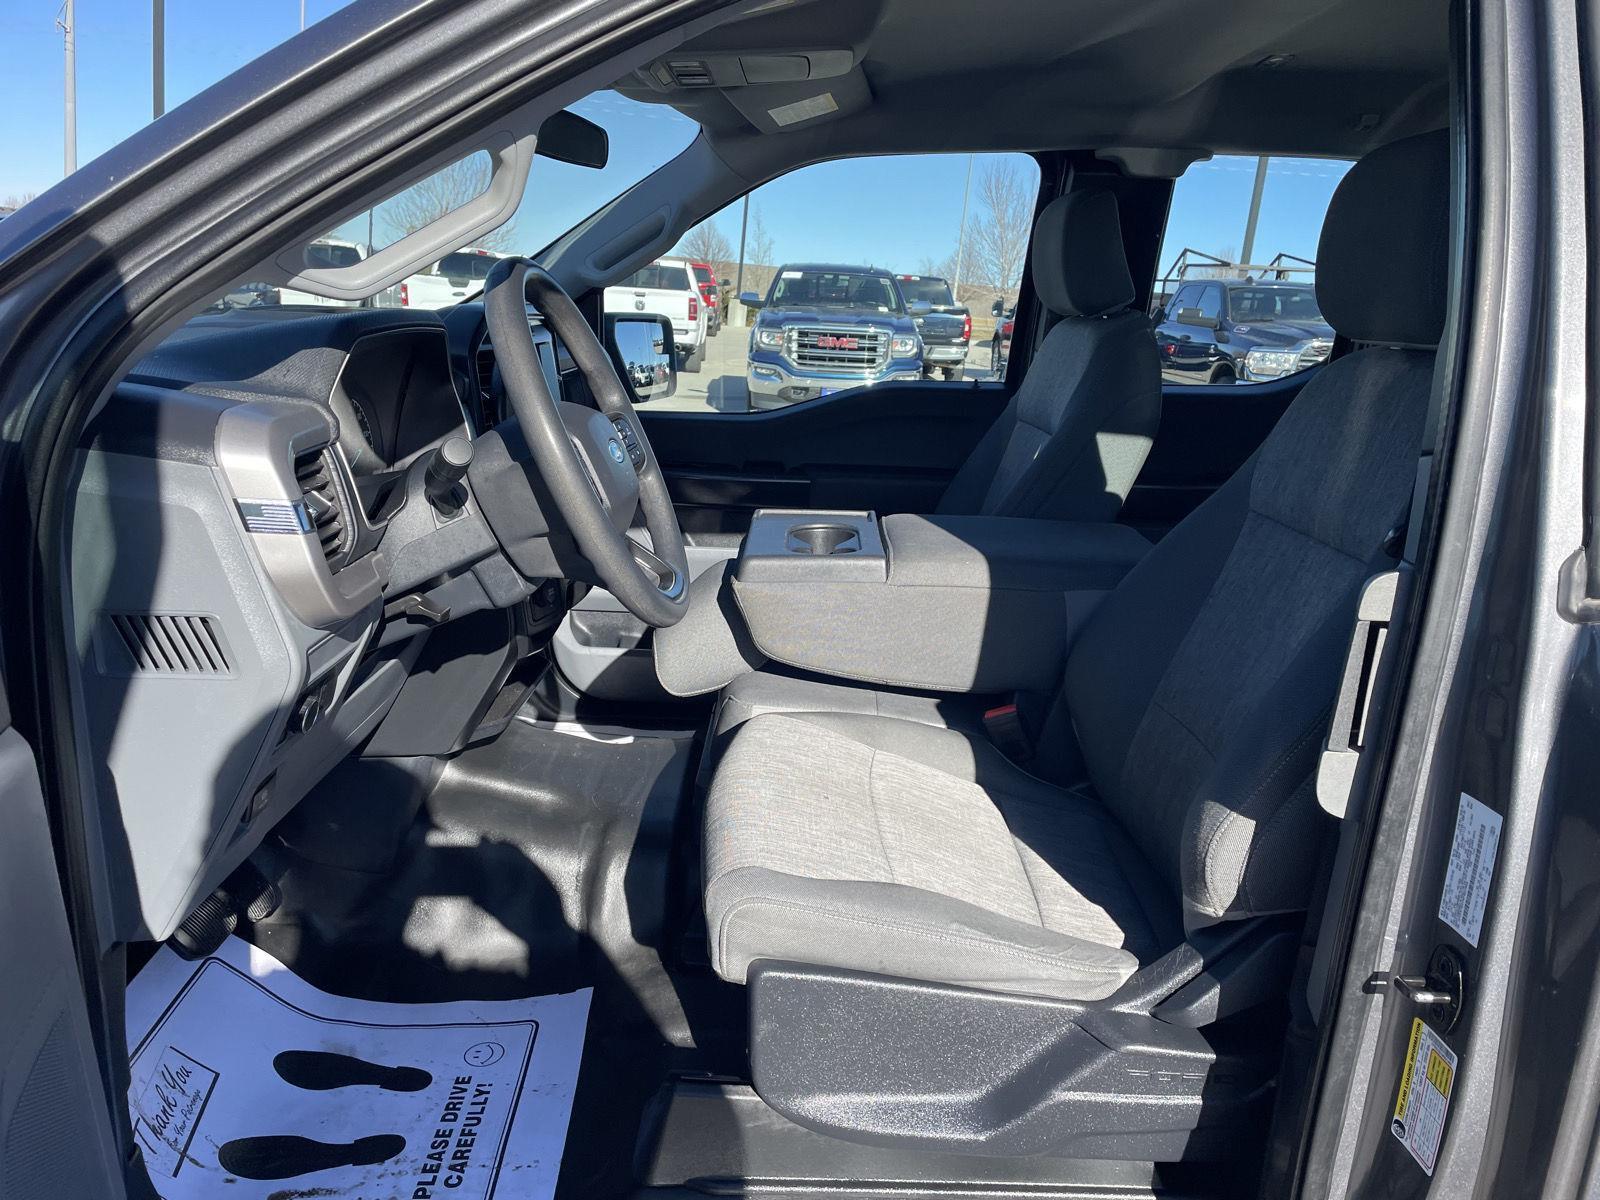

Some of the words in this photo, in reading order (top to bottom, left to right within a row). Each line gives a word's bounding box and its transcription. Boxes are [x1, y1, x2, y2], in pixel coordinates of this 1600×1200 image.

[817, 335, 859, 350] GMC
[1404, 1063, 1413, 1089] LOADING
[1410, 1022, 1421, 1063] INFORMATION
[133, 1084, 178, 1155] Thank
[161, 1063, 192, 1098] You
[412, 1128, 454, 1200] PLEASE
[440, 1075, 472, 1122] DRIVE
[443, 1083, 493, 1189] CAREFULLY!
